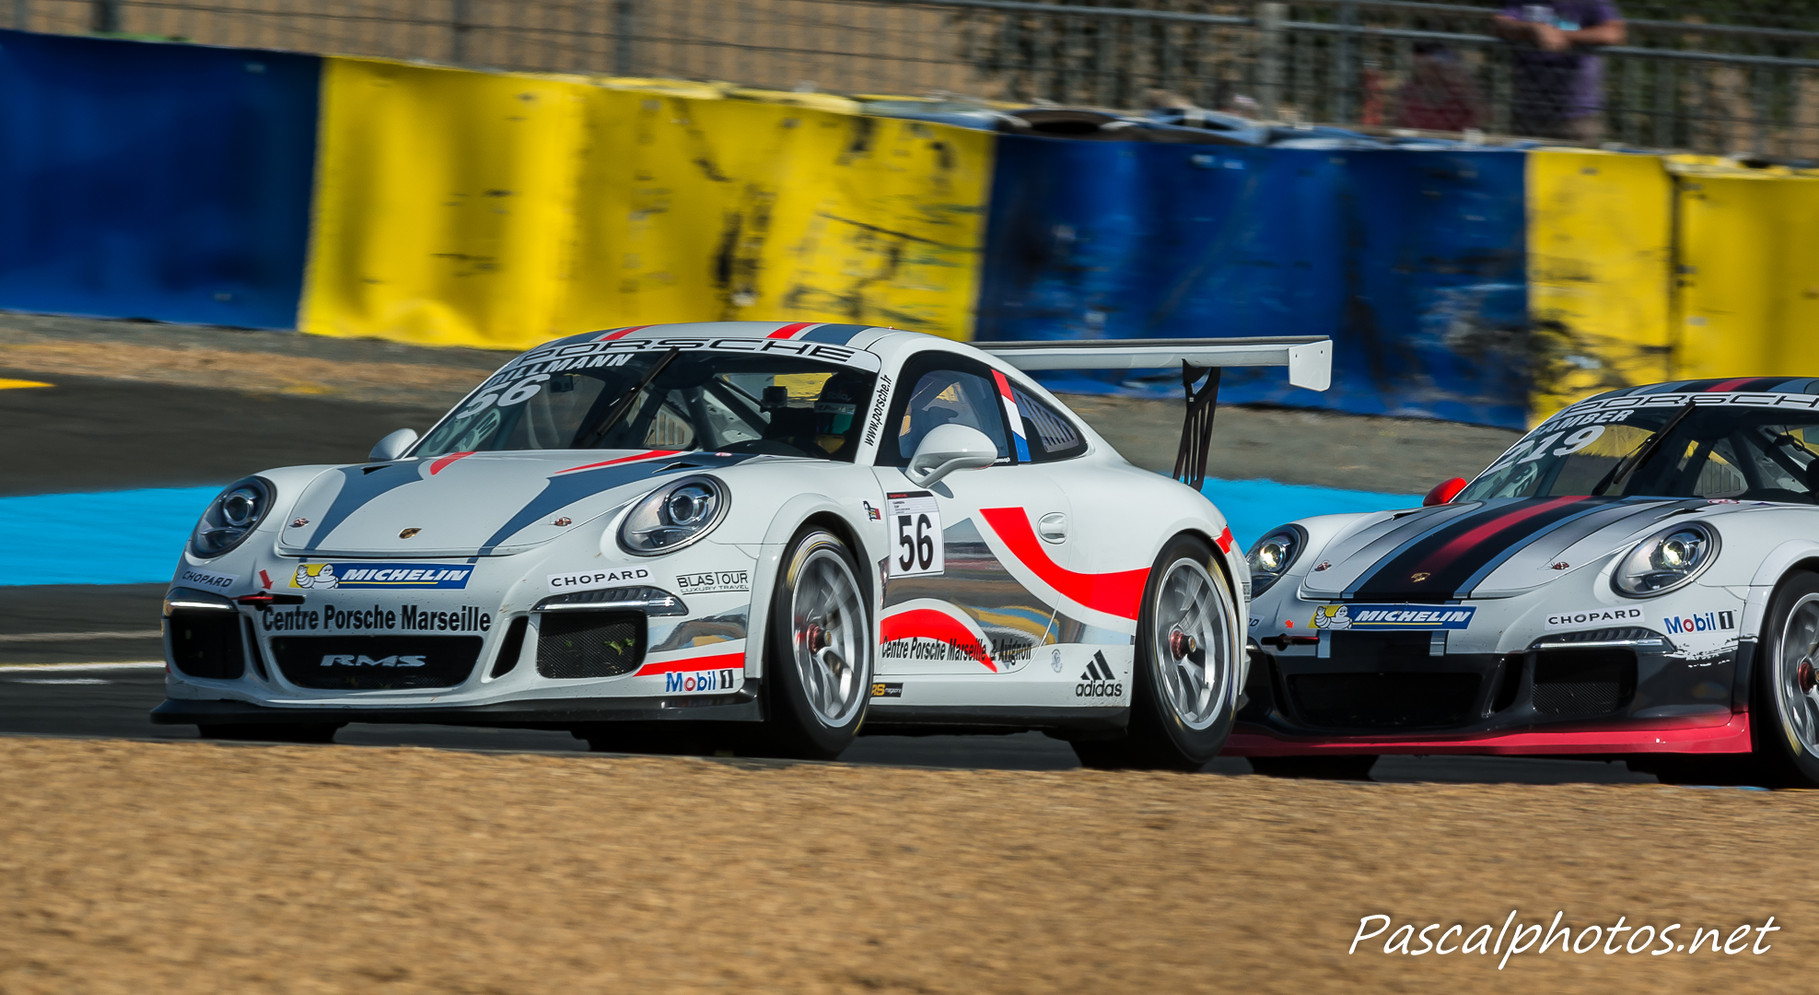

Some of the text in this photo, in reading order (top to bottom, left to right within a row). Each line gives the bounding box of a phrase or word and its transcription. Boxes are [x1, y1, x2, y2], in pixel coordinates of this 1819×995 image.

[511, 338, 856, 366] PORSCHE
[456, 374, 550, 419] 56
[864, 375, 892, 446] www.porsche.fr
[1480, 425, 1605, 479] 219
[898, 513, 934, 572] 56
[182, 570, 233, 589] CHOPARD
[340, 569, 470, 581] MICHELIN
[551, 569, 649, 587] CHOPARD
[677, 571, 748, 588] BLASTOUR
[680, 585, 717, 593] LUXURY
[262, 605, 491, 632] Centre Porsche Marseille
[1355, 611, 1471, 622] MICHELIN
[1548, 609, 1641, 625] CHOPARD
[1664, 611, 1732, 634] Mobil 1
[881, 635, 1033, 665] Centre Porsche Marseille & Avignon
[320, 655, 427, 667] RMS
[666, 670, 732, 692] Mobil 1
[1075, 679, 1123, 697] adidas
